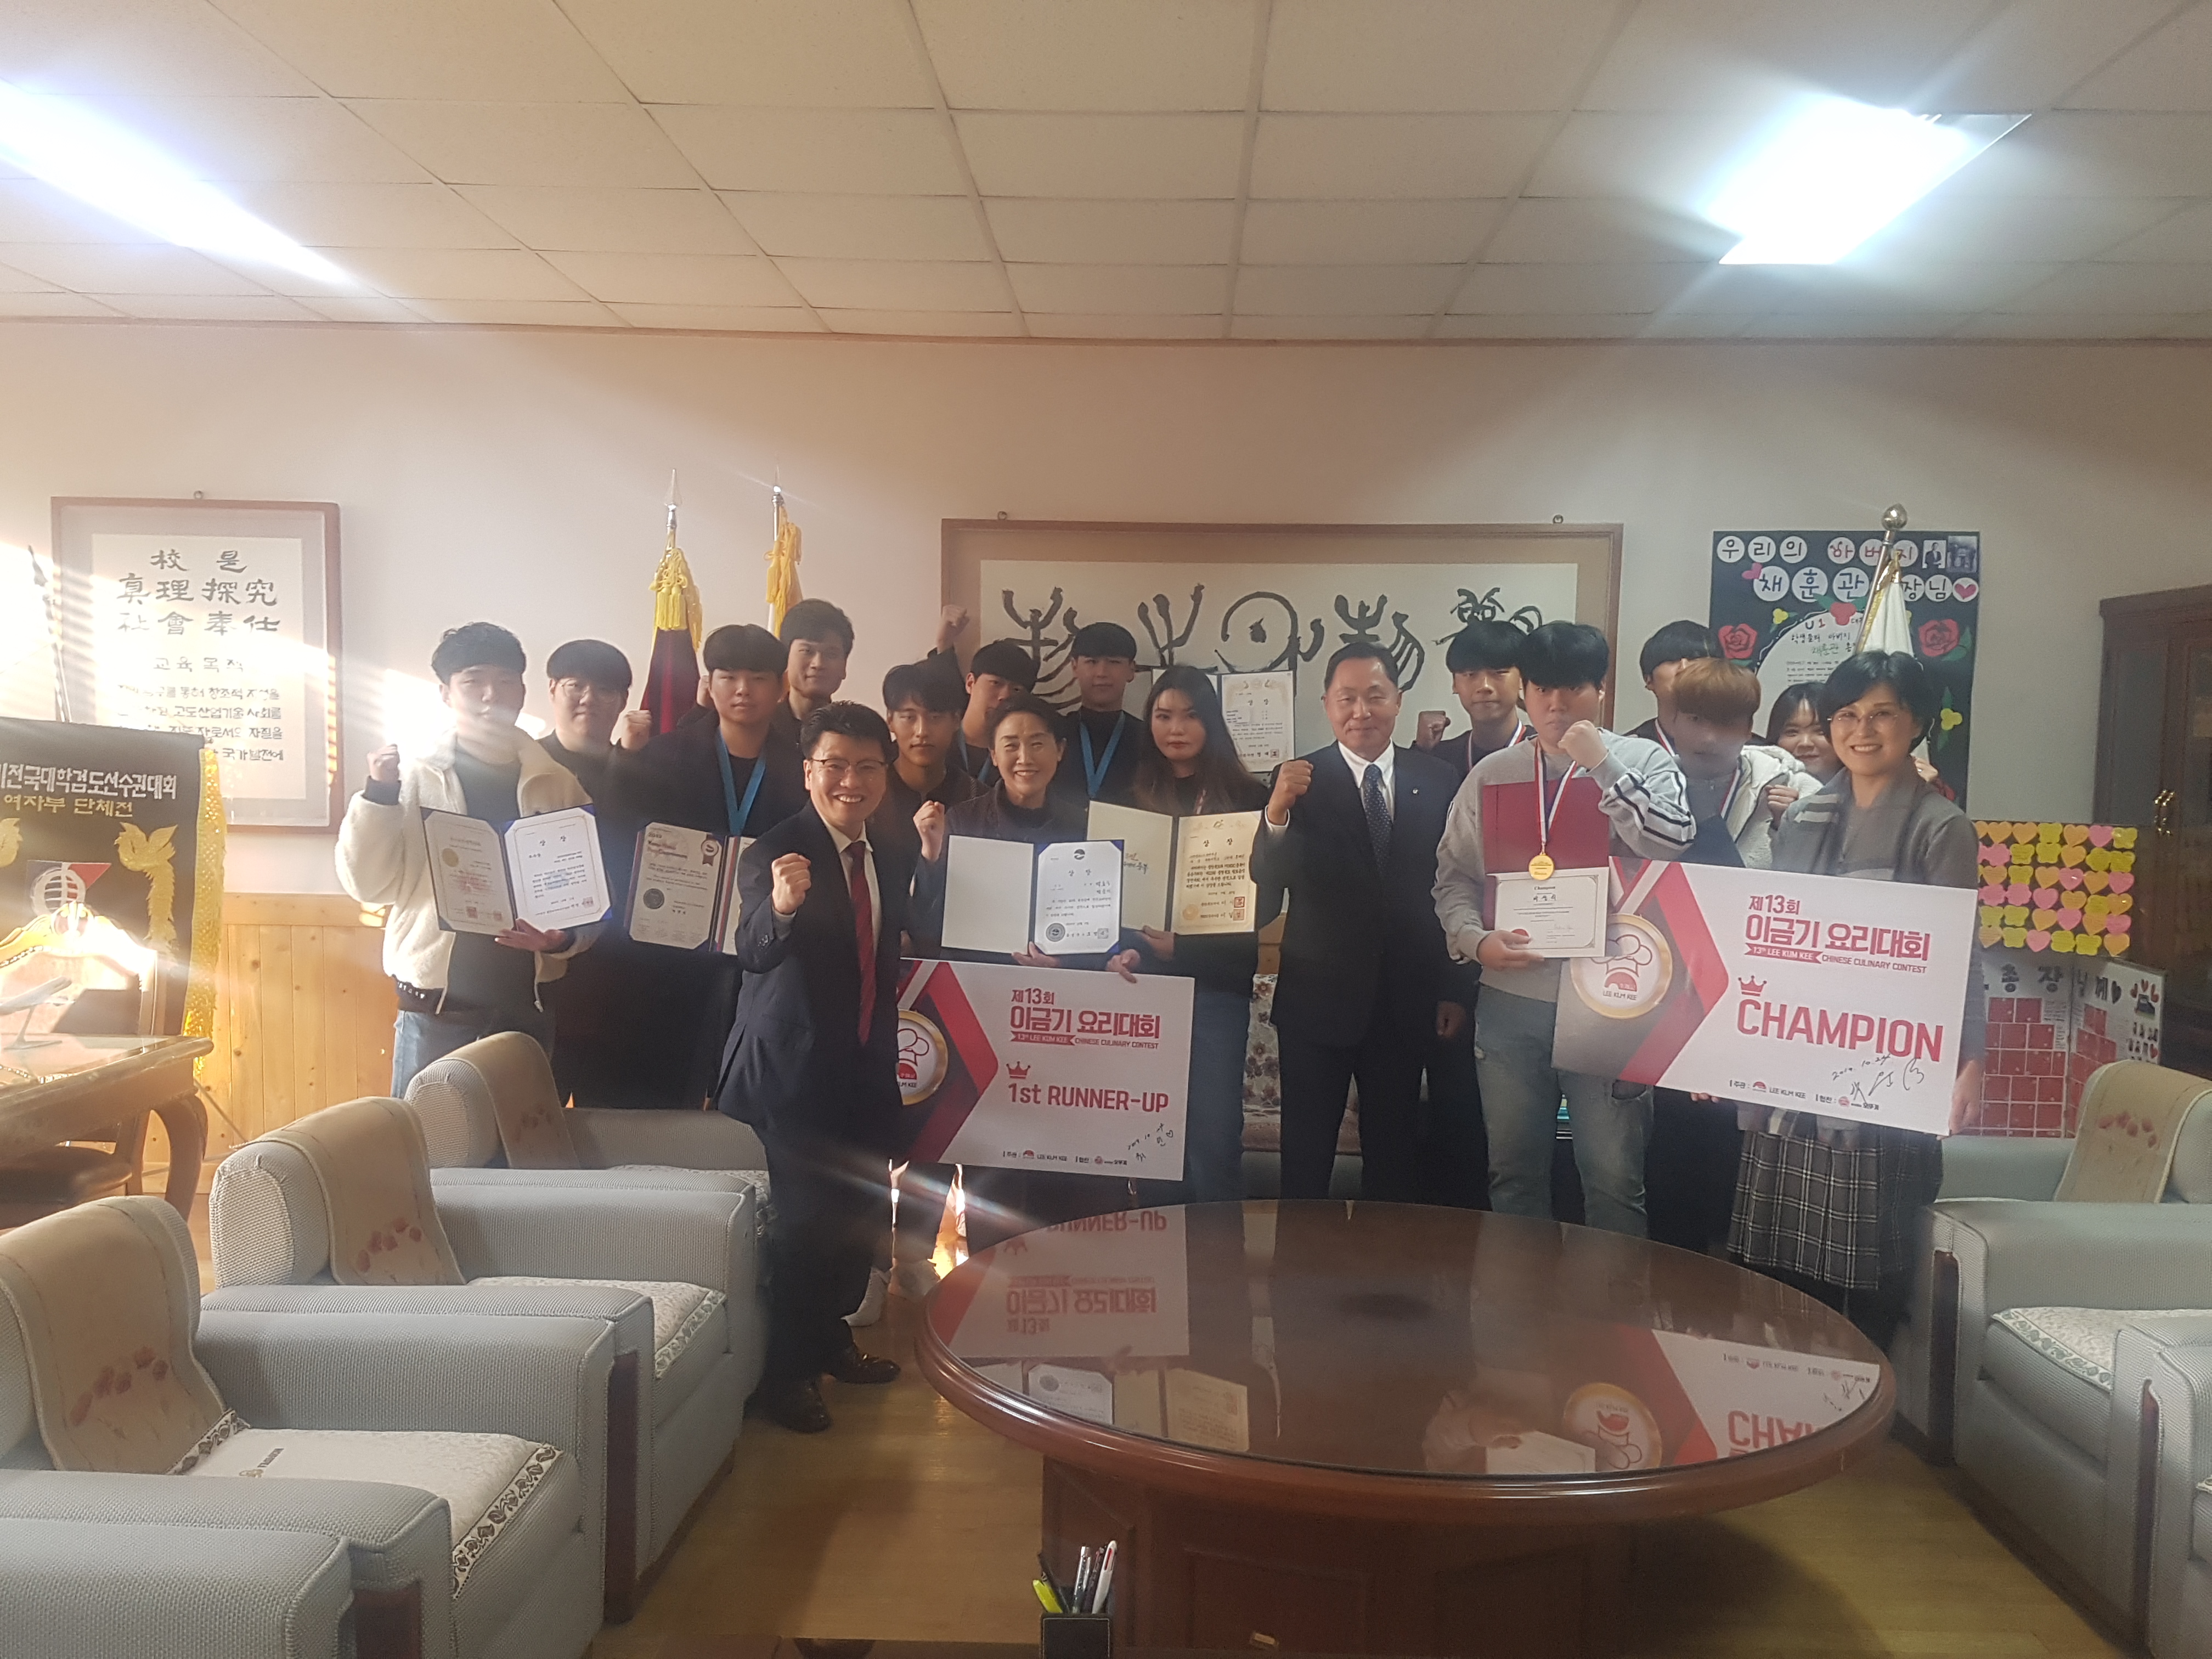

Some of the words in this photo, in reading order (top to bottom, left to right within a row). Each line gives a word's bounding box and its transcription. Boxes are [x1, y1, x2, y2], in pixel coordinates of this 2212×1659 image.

[1722, 539, 1803, 558] 우리의
[1759, 569, 1865, 600] 채훈관
[3, 794, 66, 814] 여자부
[74, 798, 133, 818] 단체전
[1748, 894, 1801, 915] 제13회
[1745, 914, 1820, 949] 이금기
[1825, 923, 1931, 961] 요리대회
[1767, 948, 1781, 956] LEE
[1799, 952, 1814, 960] KEE
[1822, 955, 1853, 965] CHINESE
[1854, 958, 1891, 970] CULINARY
[1893, 963, 1928, 974] CONTEST
[1011, 988, 1055, 1005] 제13회
[1009, 1005, 1072, 1033] 이금기
[1077, 1010, 1161, 1039] 요리대회
[1737, 998, 1944, 1062] CHAMPION
[1101, 1039, 1131, 1048] CULINARY
[1131, 1041, 1159, 1049] CONTEST
[1008, 1082, 1042, 1105] 1st
[1047, 1085, 1169, 1113] RUNNER-UP
